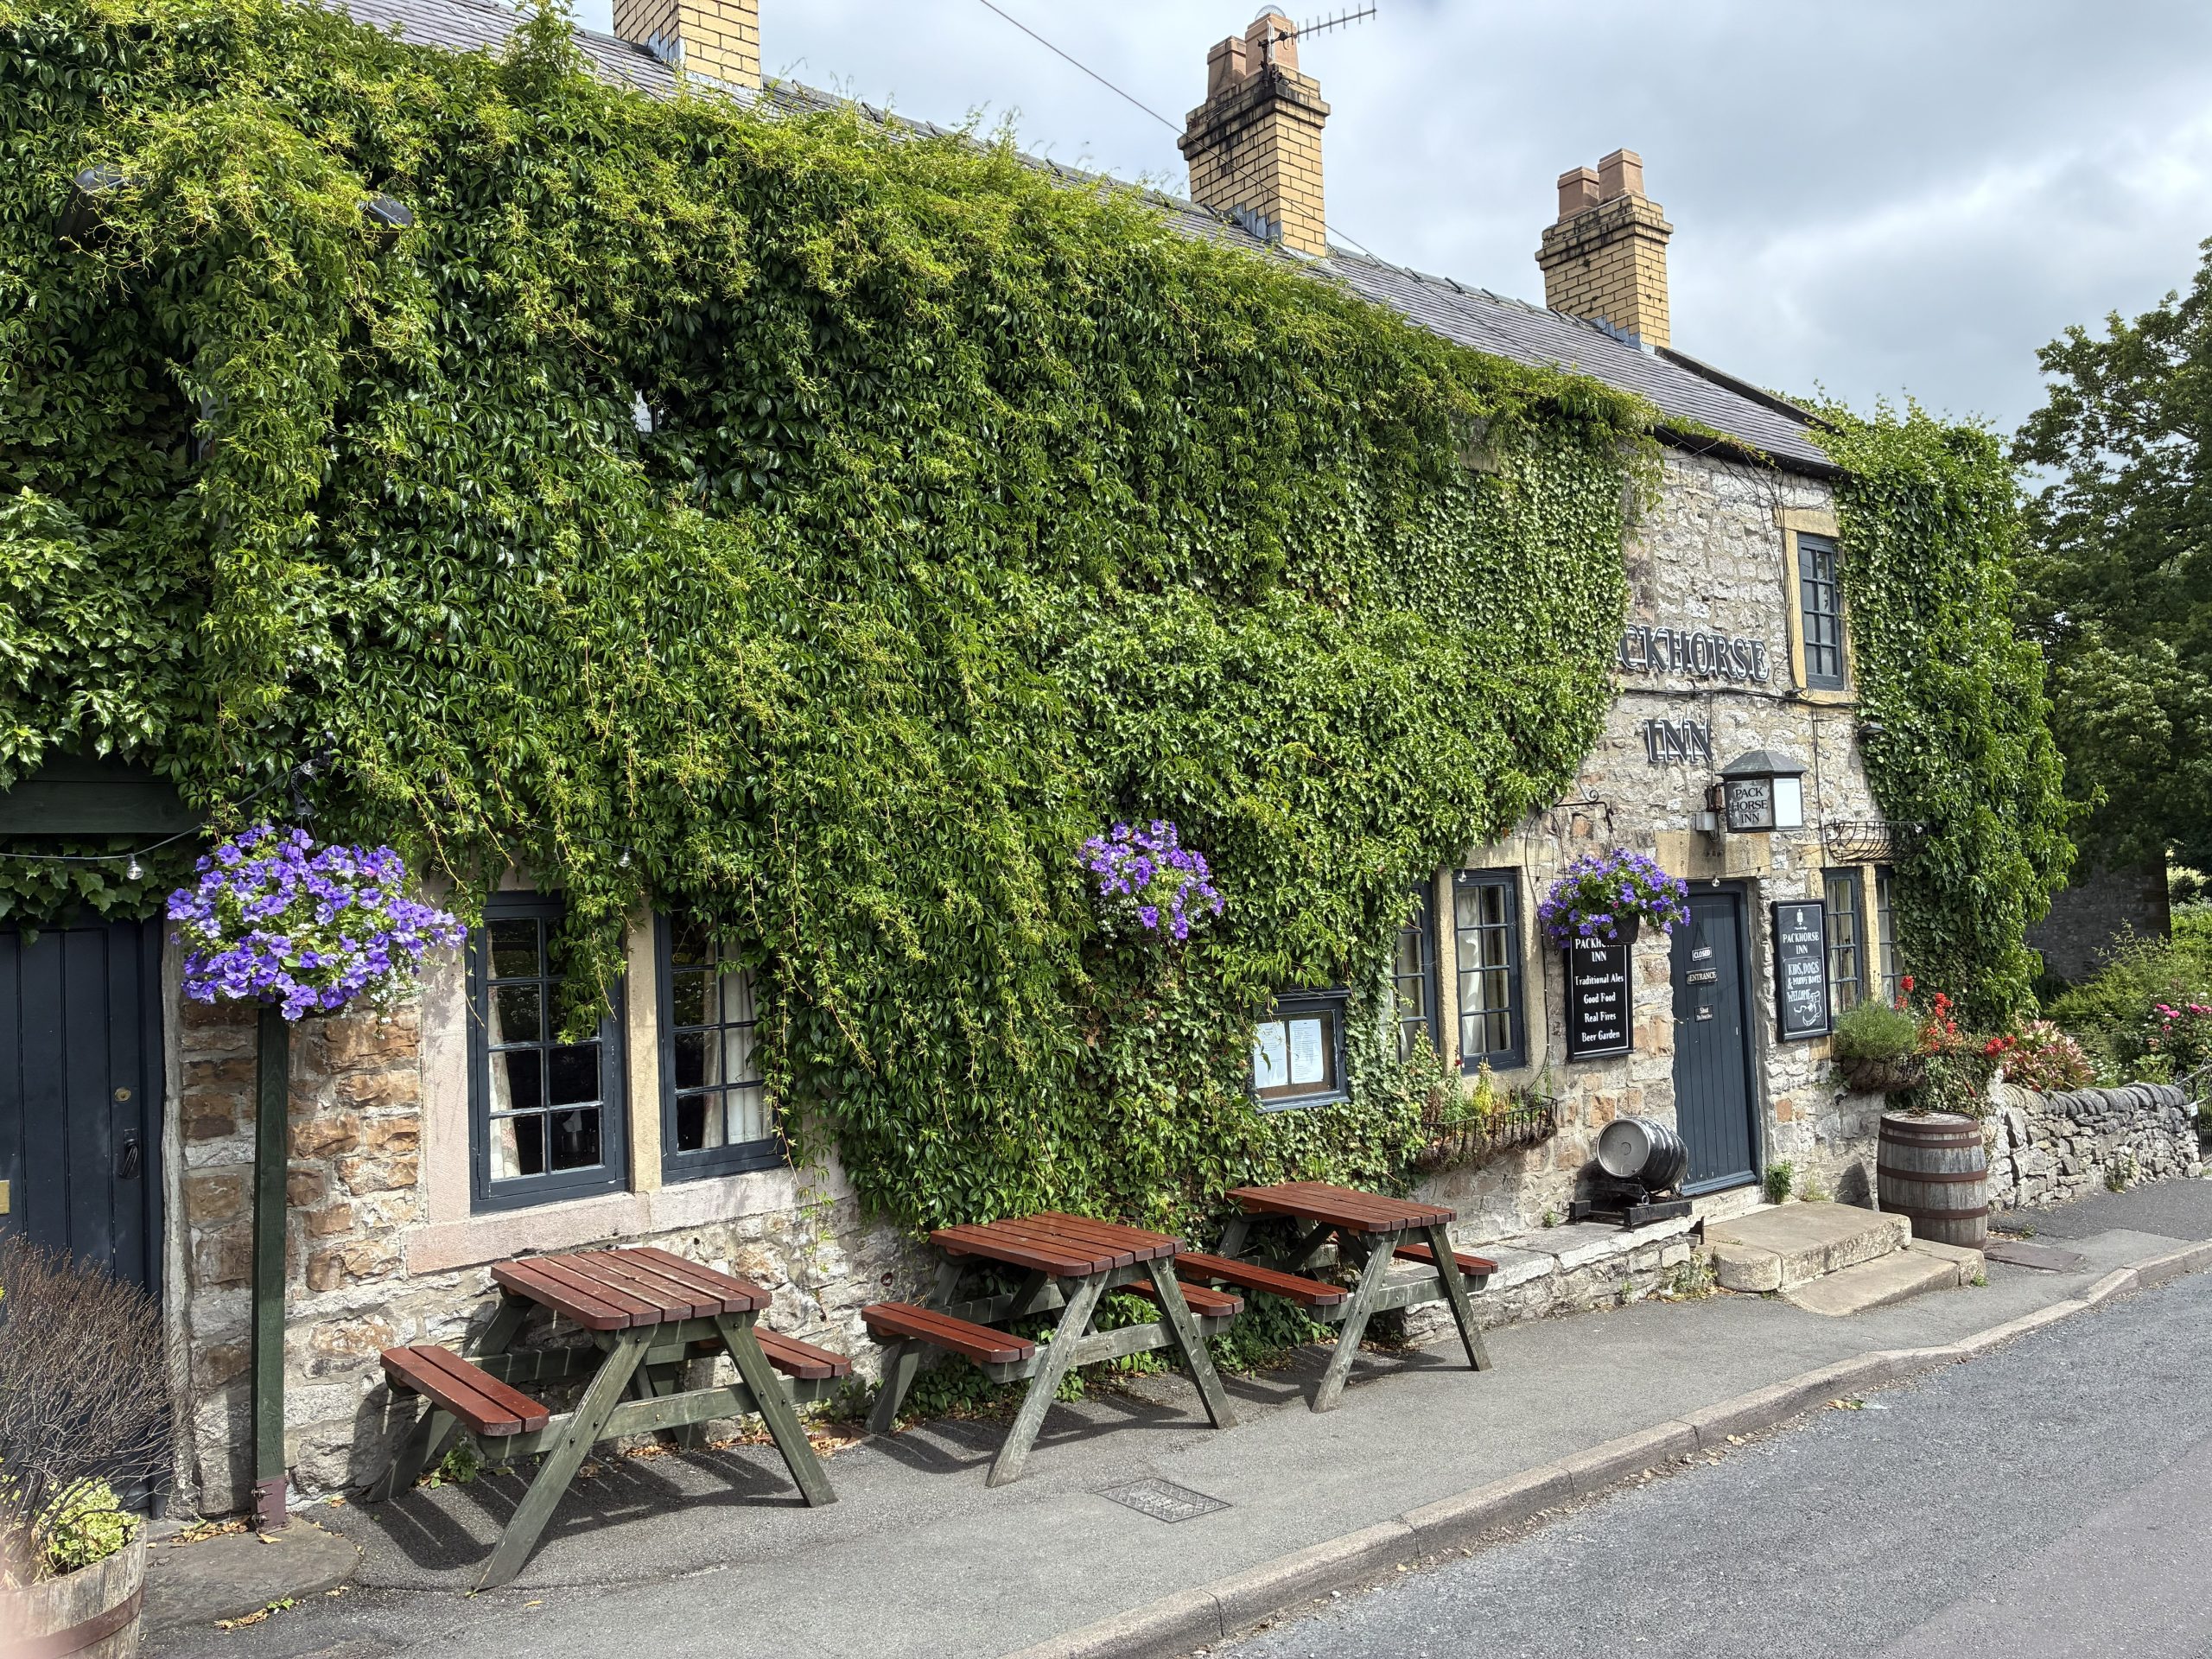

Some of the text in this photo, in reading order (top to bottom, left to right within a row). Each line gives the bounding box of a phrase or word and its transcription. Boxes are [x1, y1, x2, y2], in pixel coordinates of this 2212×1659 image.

[1643, 718, 1713, 763] INN
[1735, 787, 1764, 798] PACK
[1732, 799, 1768, 811] HORSE
[1741, 812, 1760, 823] INN
[1783, 932, 1819, 943] PACKHORSE
[1574, 938, 1621, 949] PACKH
[1694, 950, 1710, 958] CLOSED
[1796, 945, 1808, 954] INN
[1592, 951, 1606, 962] INN
[1575, 973, 1624, 985] Traditional Ales
[1690, 972, 1716, 981] ENTRANCE
[1584, 992, 1616, 1003] Good Food
[1787, 989, 1810, 1002] WELCOME
[1585, 1012, 1616, 1022] Real Fires
[1582, 1029, 1620, 1042] Beer Garden
